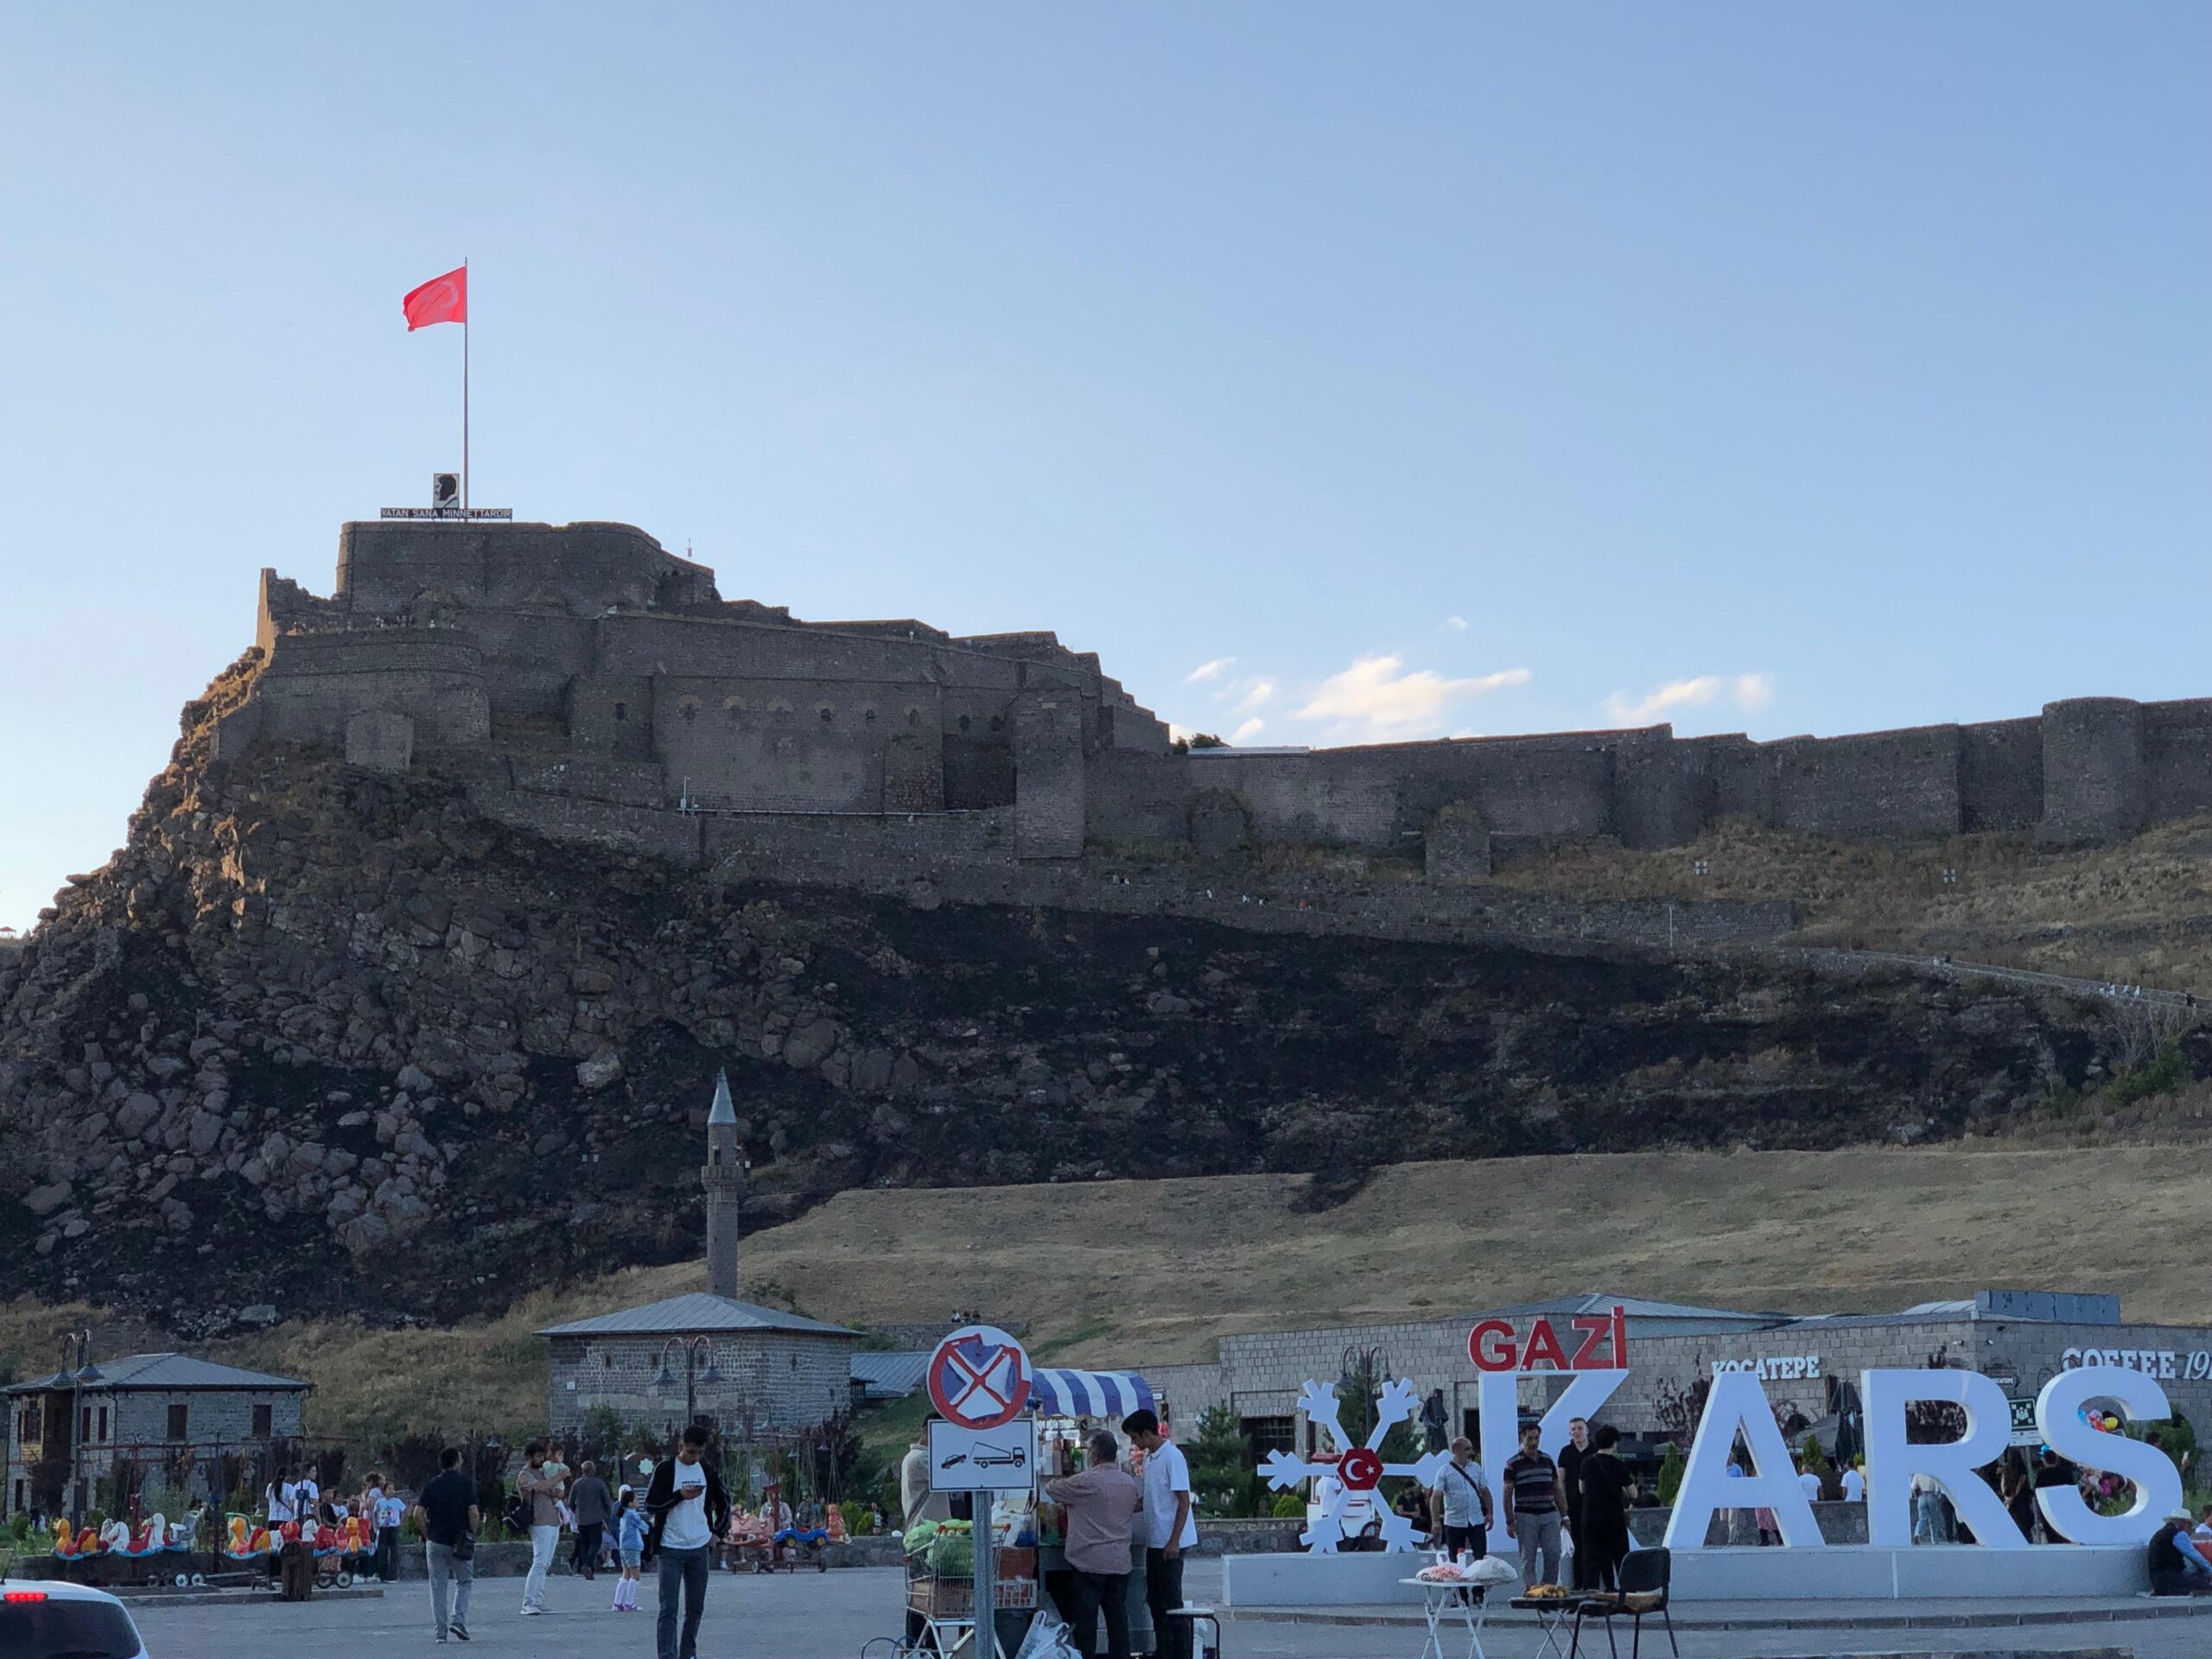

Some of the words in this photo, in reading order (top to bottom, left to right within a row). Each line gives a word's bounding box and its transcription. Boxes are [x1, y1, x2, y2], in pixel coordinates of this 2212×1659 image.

[381, 509, 409, 518] VATAN
[412, 509, 438, 518] SANA
[2183, 1351, 2212, 1380] 19
[1478, 1366, 2183, 1553] KARS
